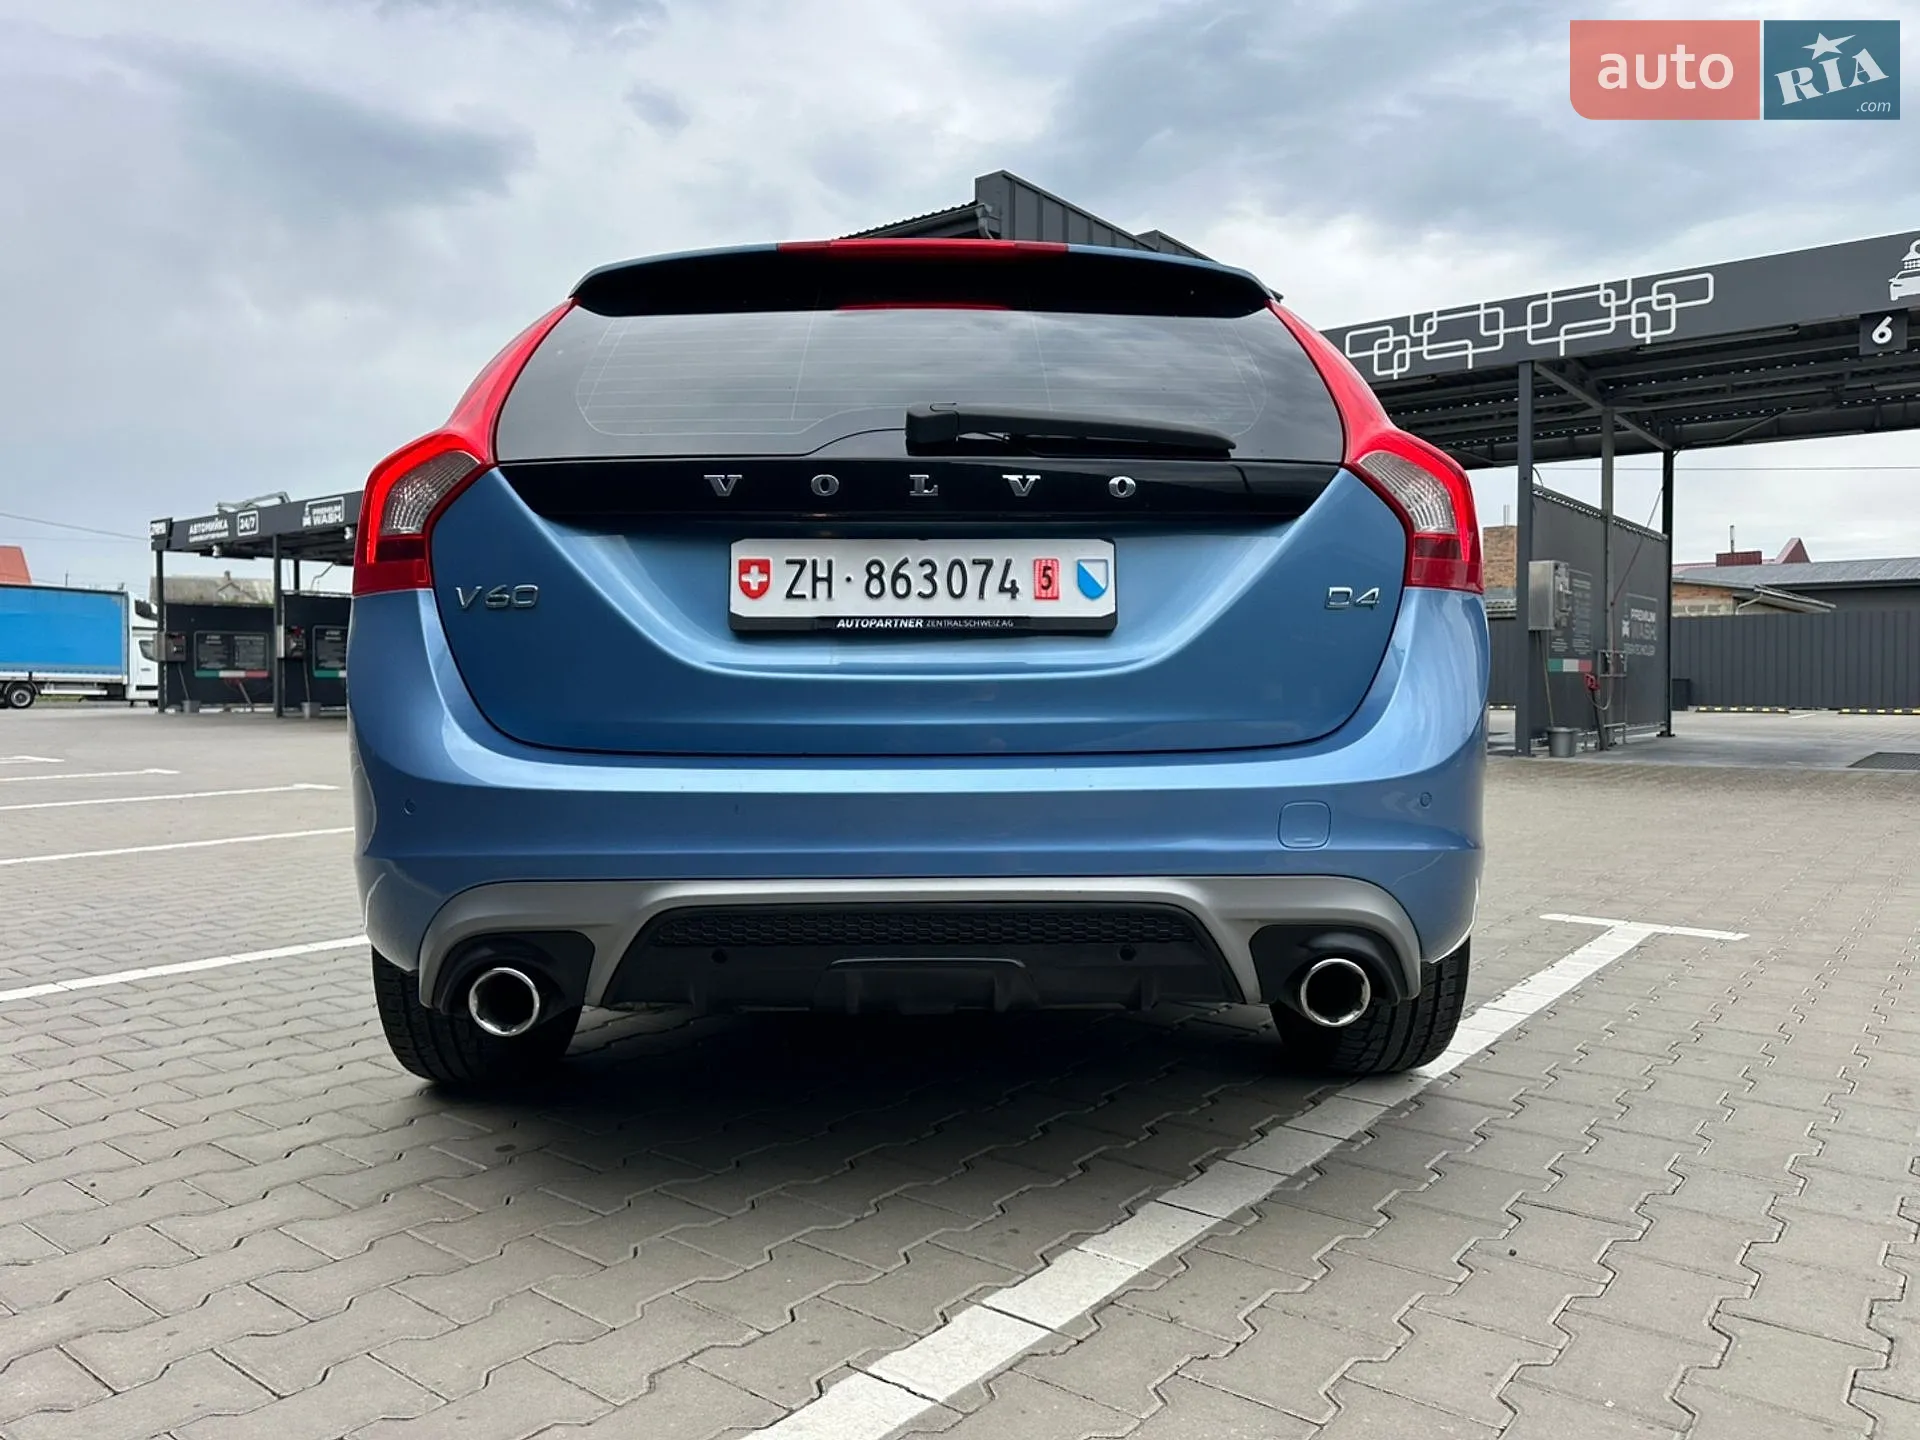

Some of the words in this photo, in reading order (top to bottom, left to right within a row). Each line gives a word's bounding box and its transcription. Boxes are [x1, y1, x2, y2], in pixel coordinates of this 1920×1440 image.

[1872, 316, 1893, 344] 6
[703, 474, 1137, 498] VOLVO
[863, 557, 1020, 600] 863074
[1041, 565, 1052, 590] 5
[455, 584, 539, 609] V60
[1325, 586, 1380, 610] D4
[836, 618, 924, 629] AUTOPARTNER
